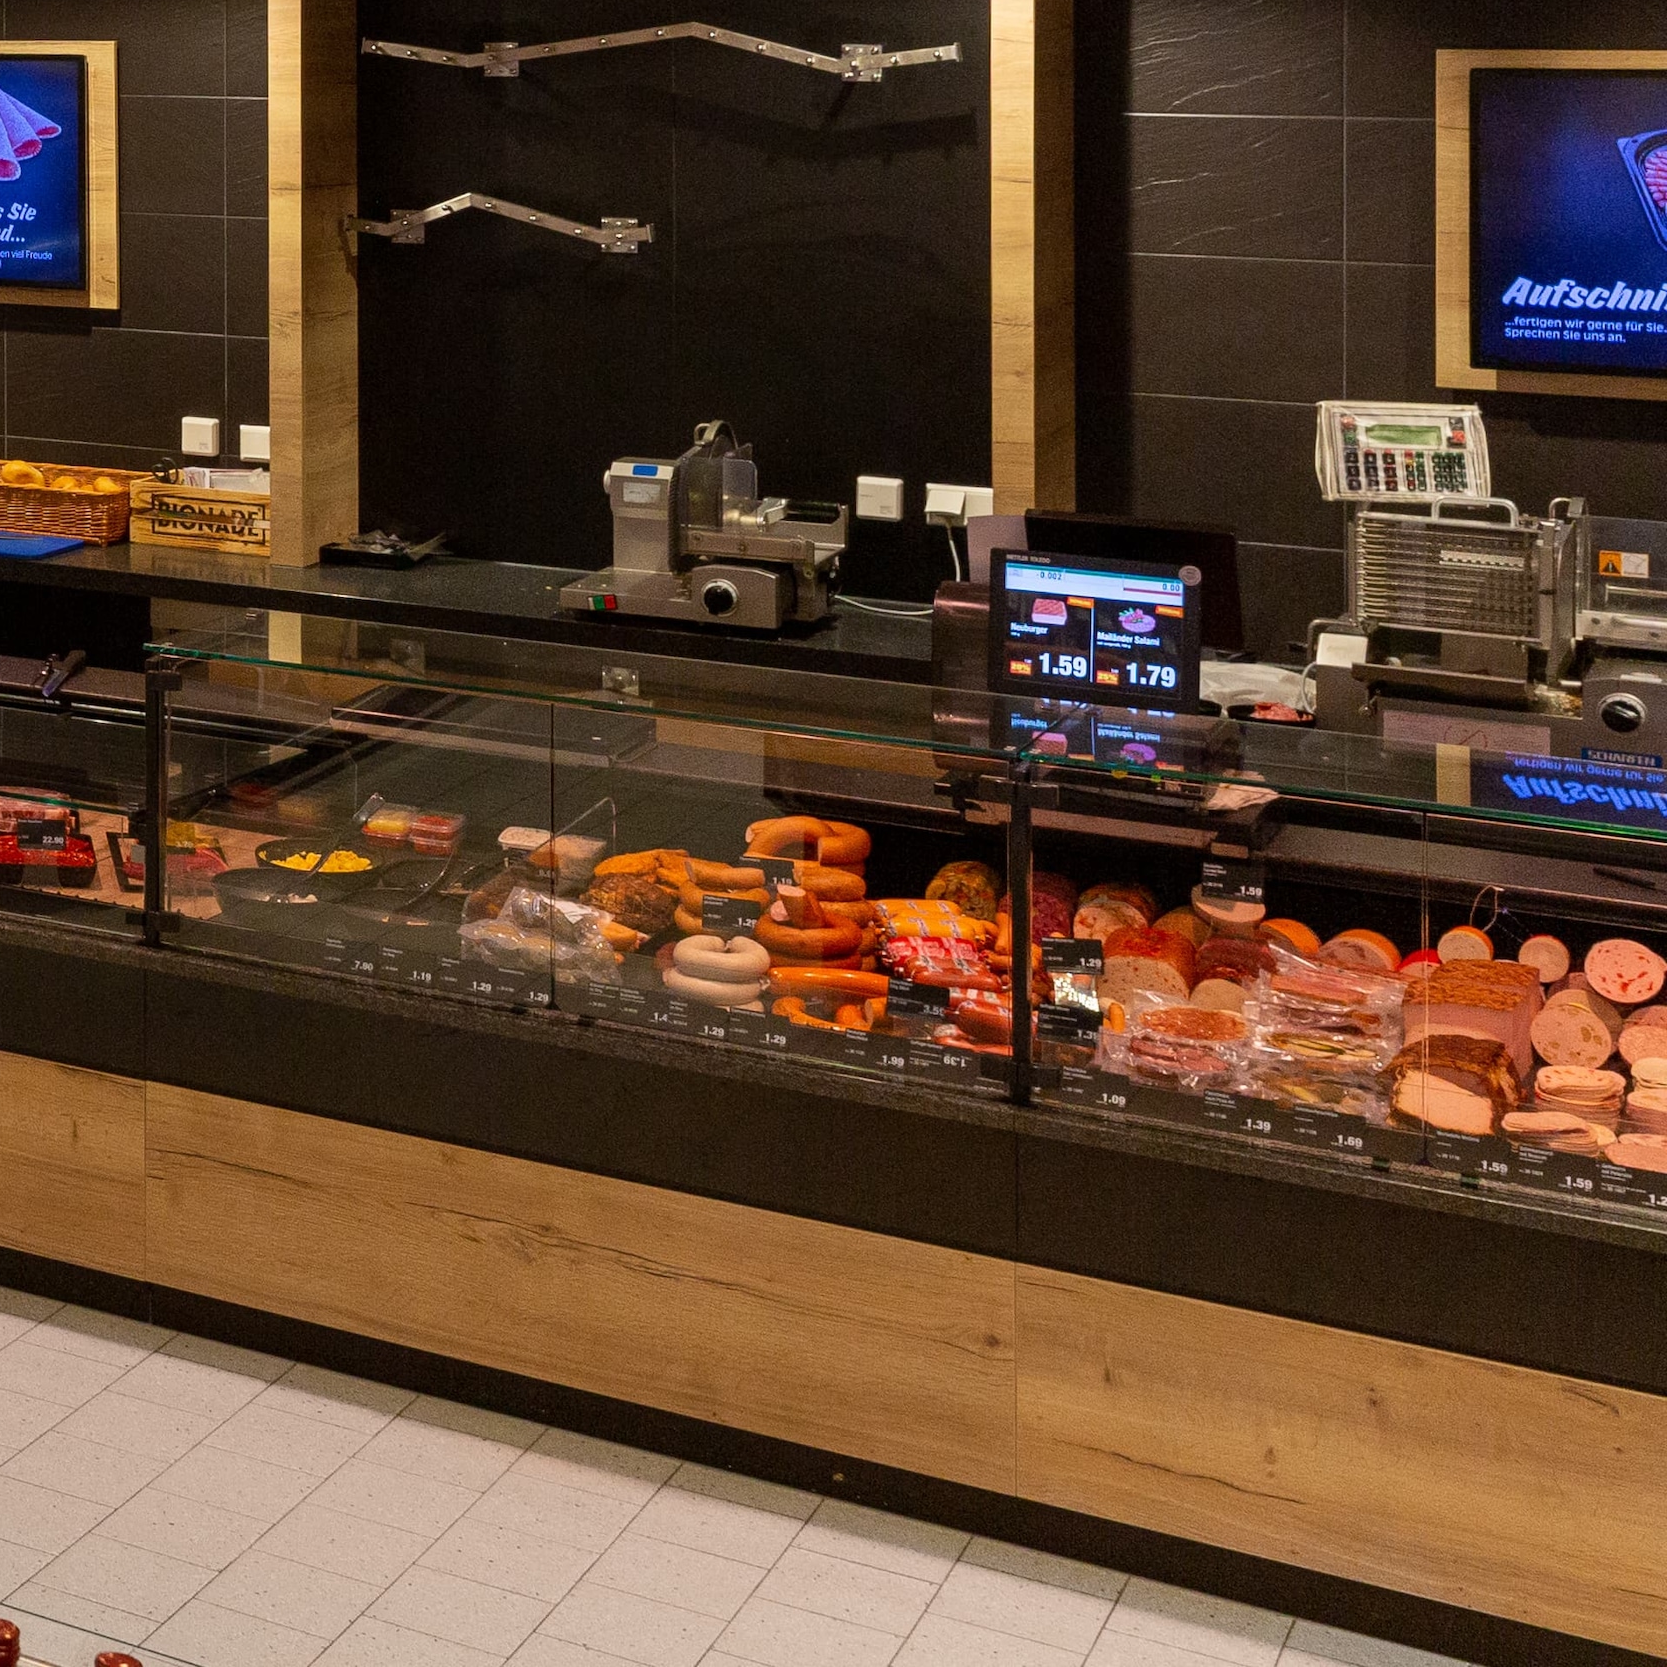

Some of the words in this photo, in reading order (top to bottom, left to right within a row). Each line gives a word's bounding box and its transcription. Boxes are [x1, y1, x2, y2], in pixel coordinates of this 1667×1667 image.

[7, 202, 37, 221] Sie
[25, 250, 53, 261] Freude
[1502, 276, 1667, 312] Aufschni
[1564, 319, 1585, 329] wir
[1587, 320, 1623, 331] gerne
[1625, 321, 1644, 332] für
[1505, 327, 1560, 339] Sprechen
[1563, 330, 1581, 340] Sie
[1584, 332, 1605, 342] uns
[158, 502, 260, 537] BIONADE
[1010, 622, 1049, 635] Neuburger
[1097, 631, 1133, 645] Mailänder
[1134, 635, 1160, 647] Salami
[1038, 652, 1088, 678] 1.59
[1126, 662, 1177, 688] 1.79
[653, 1012, 668, 1024] 1.4
[1480, 1160, 1509, 1174] 1.59
[1565, 1175, 1593, 1191] 1.59
[1648, 1194, 1667, 1207] 1.2
